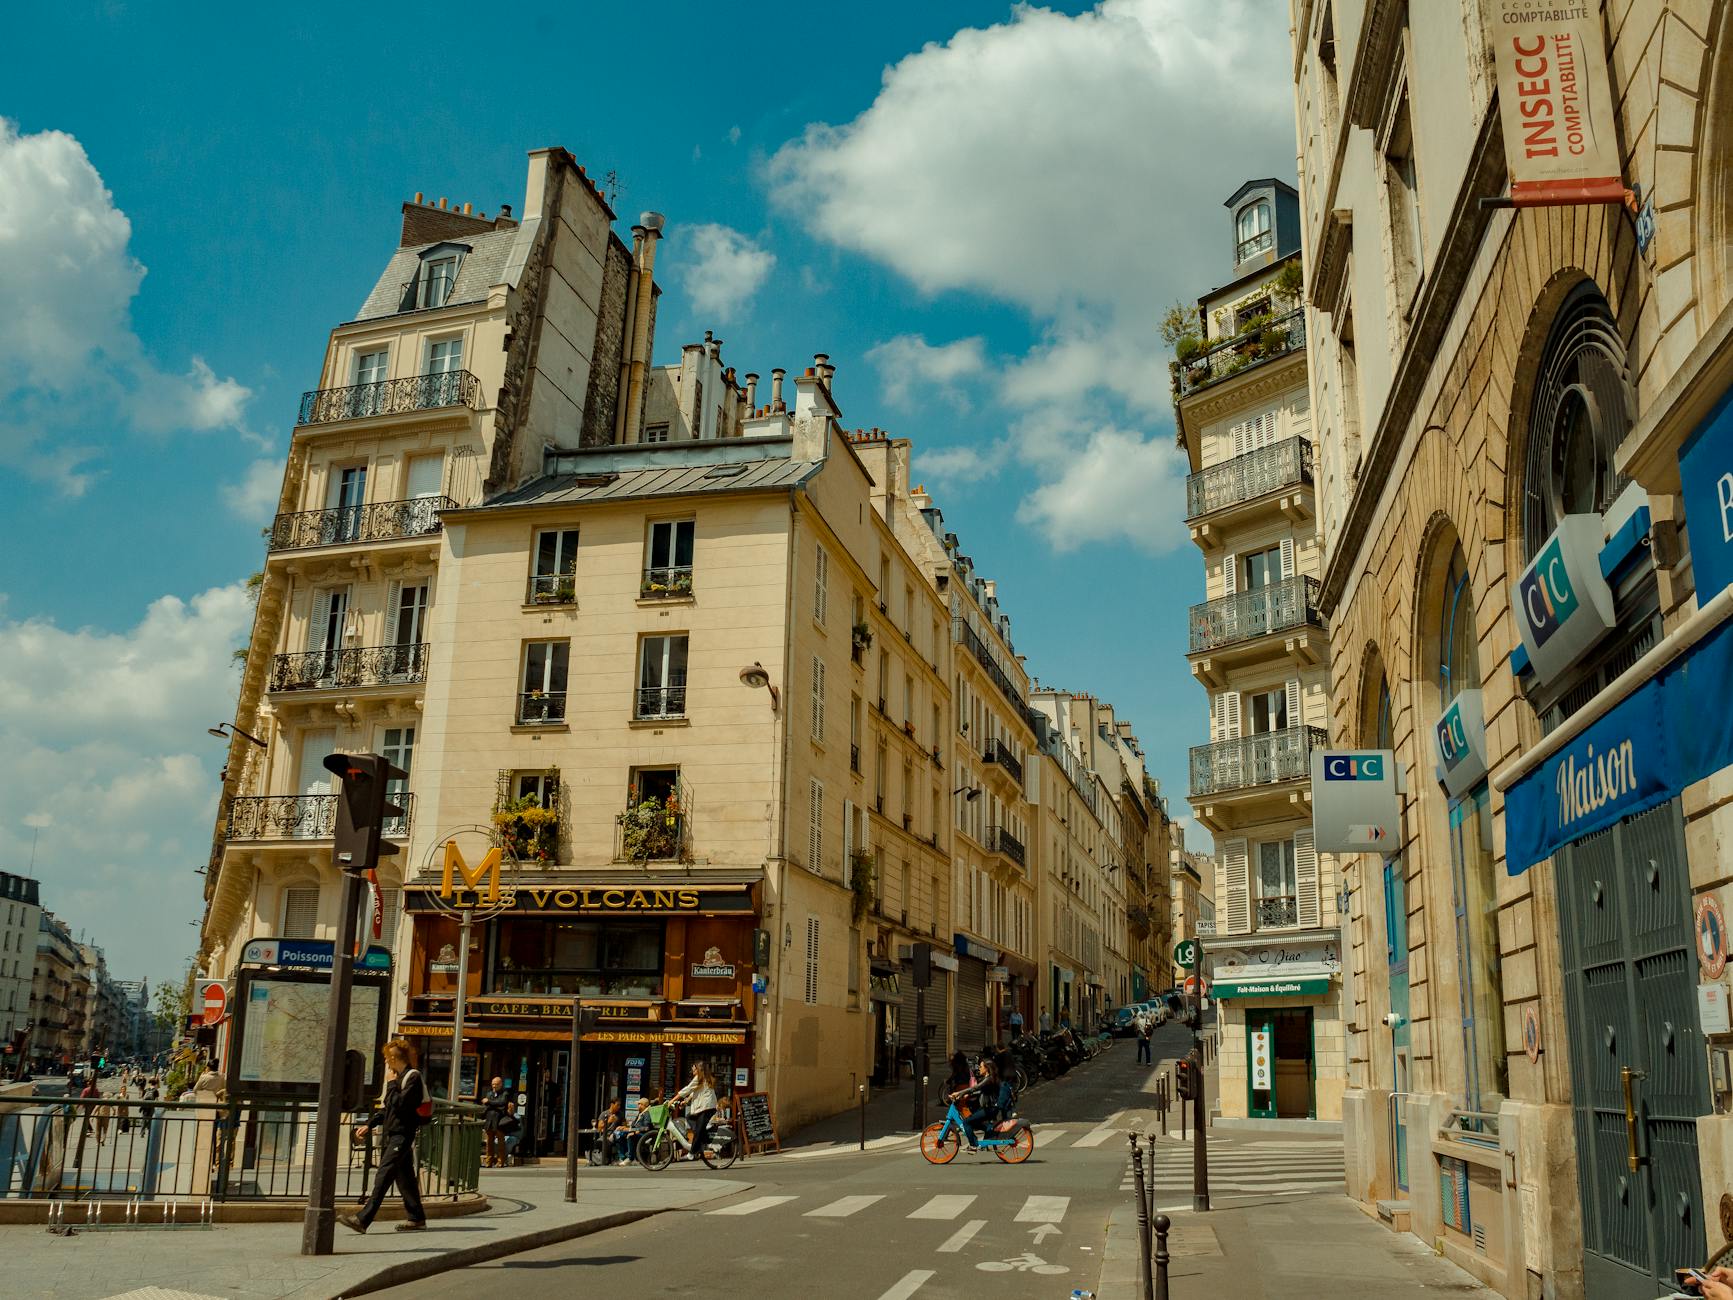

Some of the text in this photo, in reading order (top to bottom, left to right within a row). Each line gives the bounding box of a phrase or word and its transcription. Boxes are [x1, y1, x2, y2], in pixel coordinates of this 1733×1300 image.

[1512, 34, 1559, 159] INSECC
[1550, 32, 1585, 156] COMPTABILITÉ
[1527, 557, 1569, 629] CIC
[1441, 715, 1464, 760] CIC
[1329, 759, 1377, 777] CIC
[1556, 738, 1637, 829] Maison
[441, 840, 502, 902] M
[373, 883, 381, 925] TABAC
[529, 890, 699, 909] VOLCANS
[282, 949, 333, 963] Poissonn
[404, 1026, 455, 1036] LES VOLCAN
[542, 1004, 629, 1018] BRARIE
[598, 1032, 738, 1044] LES PARIS MUTUELS URBAINS
